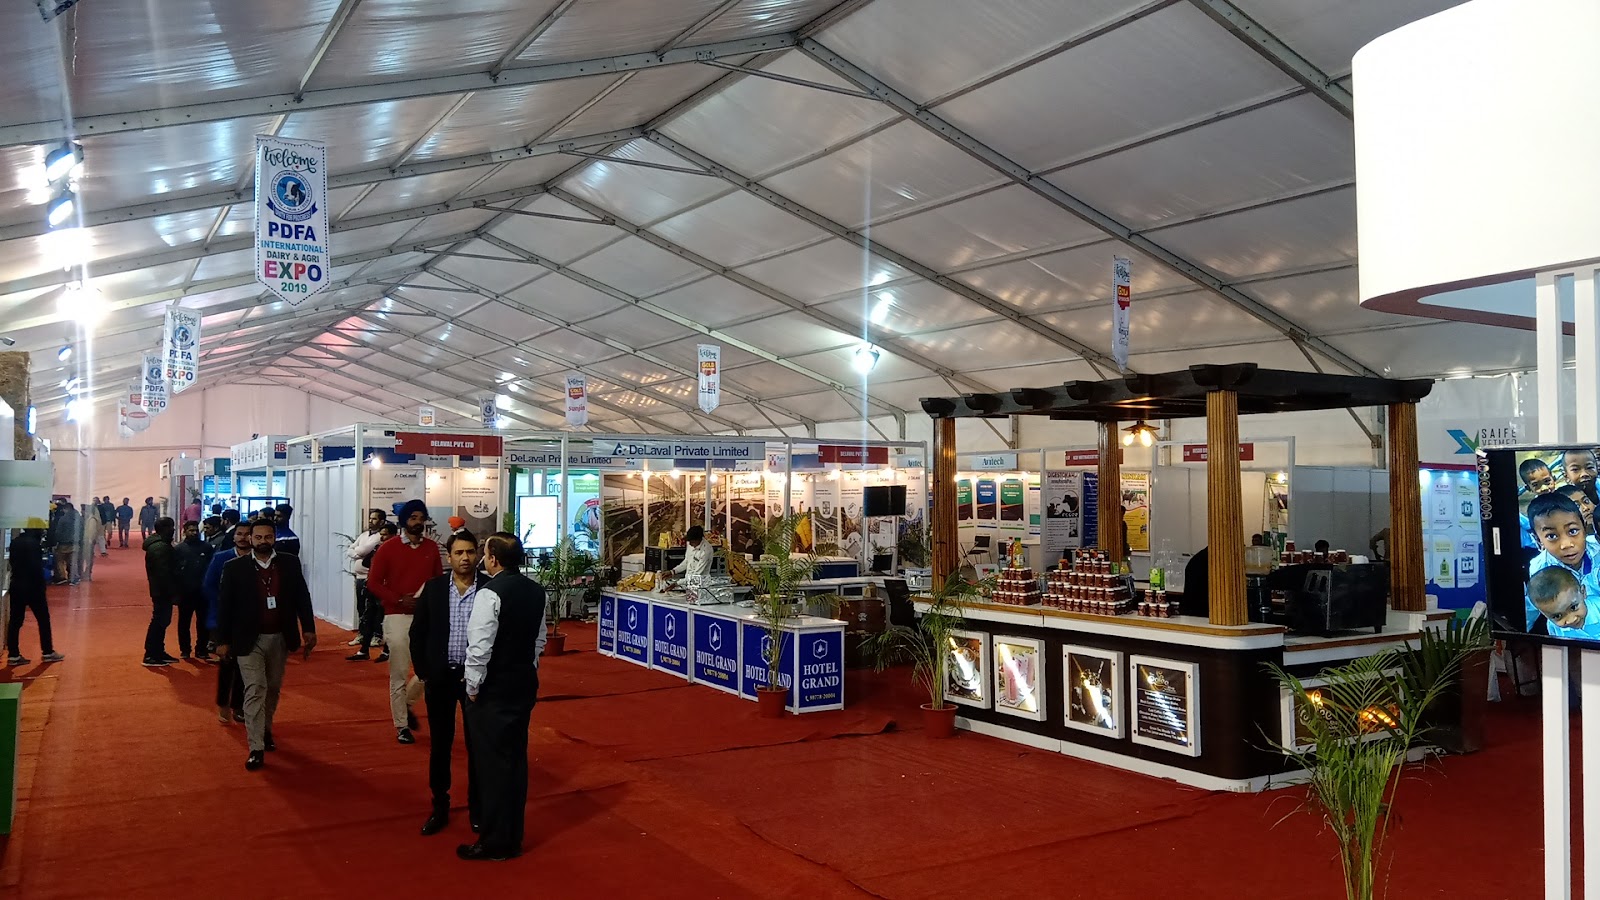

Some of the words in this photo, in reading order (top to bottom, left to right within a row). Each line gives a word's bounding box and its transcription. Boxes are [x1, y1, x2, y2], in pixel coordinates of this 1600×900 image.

[264, 146, 318, 173] Welcome
[268, 222, 316, 241] PDFA
[261, 240, 324, 253] INTERNATIONAL
[267, 250, 292, 260] DAIRY
[301, 253, 320, 262] AGRI
[264, 260, 322, 282] EXPO
[281, 282, 308, 293] 2019
[167, 369, 193, 380] EXPO
[143, 400, 166, 408] EXPO
[629, 444, 671, 456] DeLaval
[674, 445, 710, 456] Private
[712, 446, 749, 456] Limited
[510, 454, 546, 463] DeLaval
[601, 618, 614, 628] HOTEL
[601, 628, 614, 638] GRAND
[618, 630, 632, 644] HOTEL
[632, 634, 647, 648] GRAND
[654, 639, 670, 653] HOTEL
[670, 643, 687, 660] GRAND
[696, 650, 715, 667] HOTEL
[715, 655, 737, 673] GRAND
[745, 664, 766, 681] HOTEL
[803, 662, 838, 676] HOTEL
[802, 676, 839, 690] GRAND
